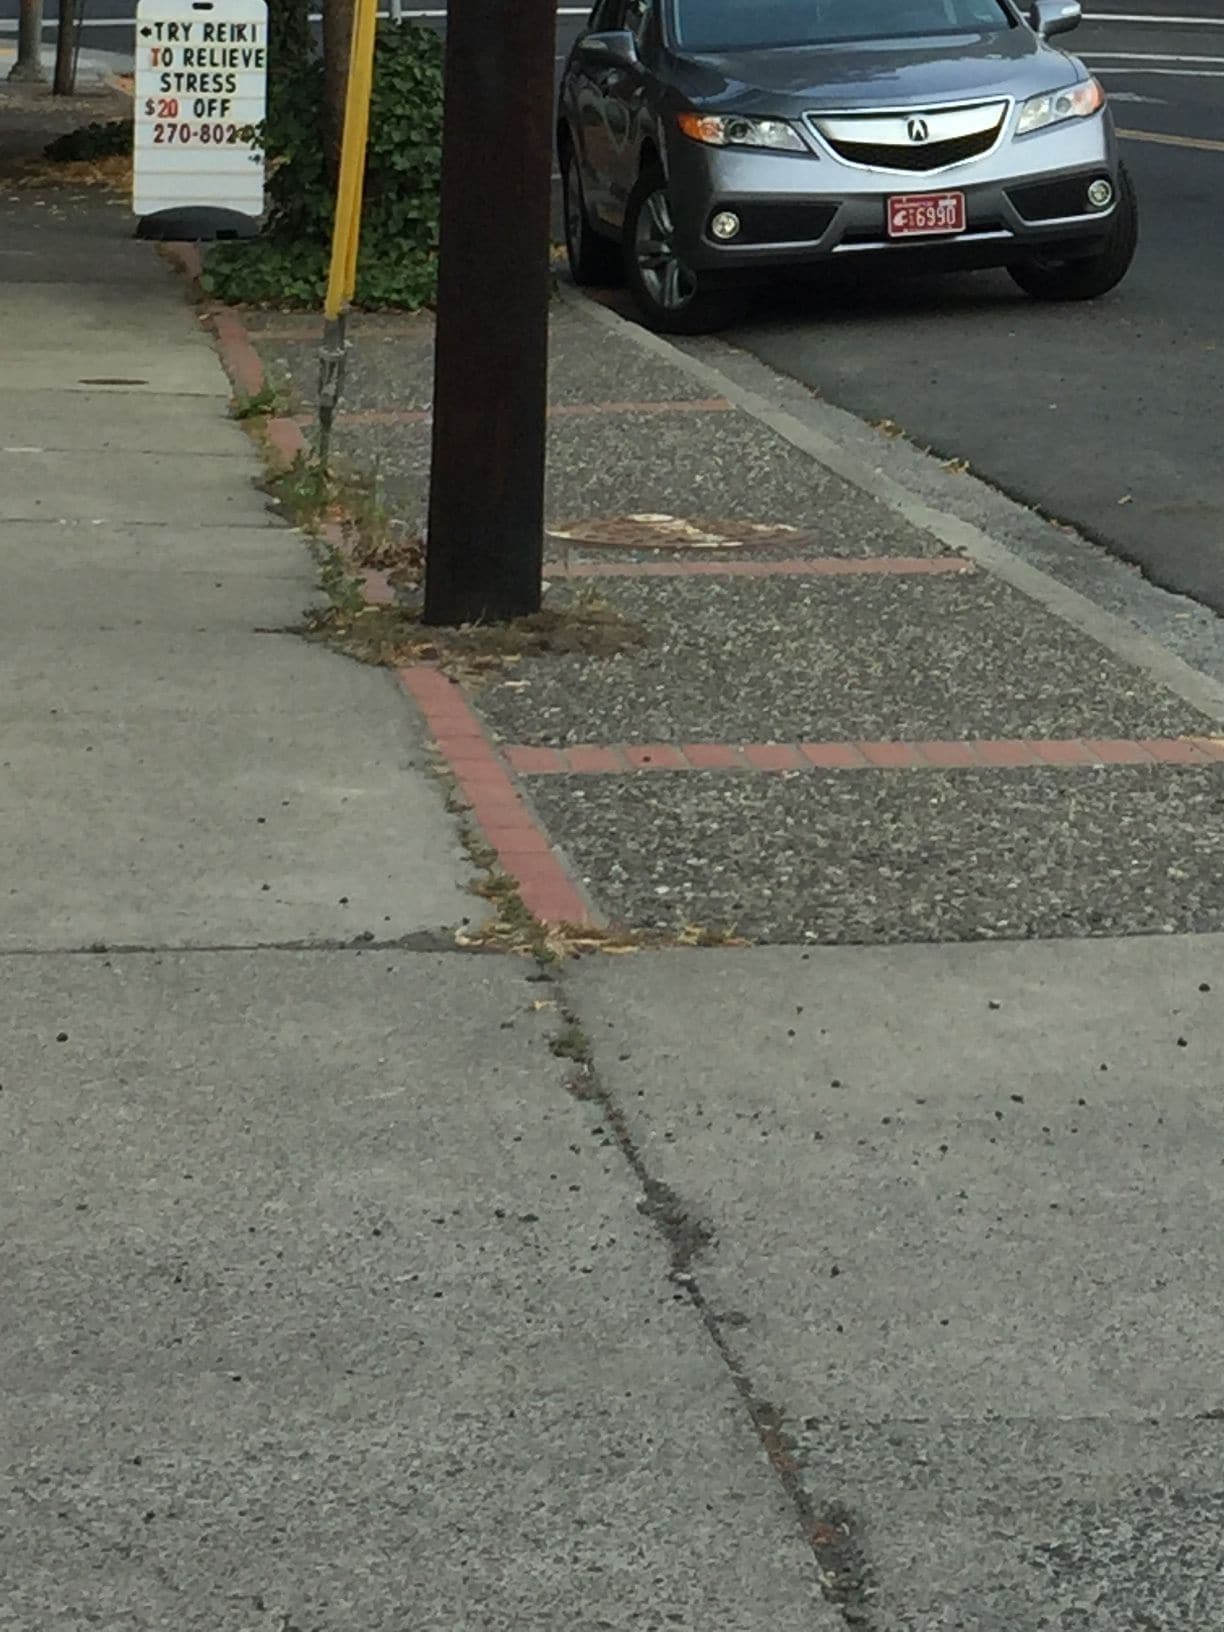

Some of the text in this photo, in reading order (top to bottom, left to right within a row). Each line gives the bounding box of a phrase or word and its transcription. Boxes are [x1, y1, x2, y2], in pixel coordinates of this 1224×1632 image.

[154, 21, 256, 43] TRY REIKI
[150, 47, 265, 68] TO RELIEVE
[160, 72, 237, 93] STRESS
[144, 98, 231, 118] $20 OFF
[153, 123, 256, 144] 270-802
[916, 206, 956, 227] 6990
